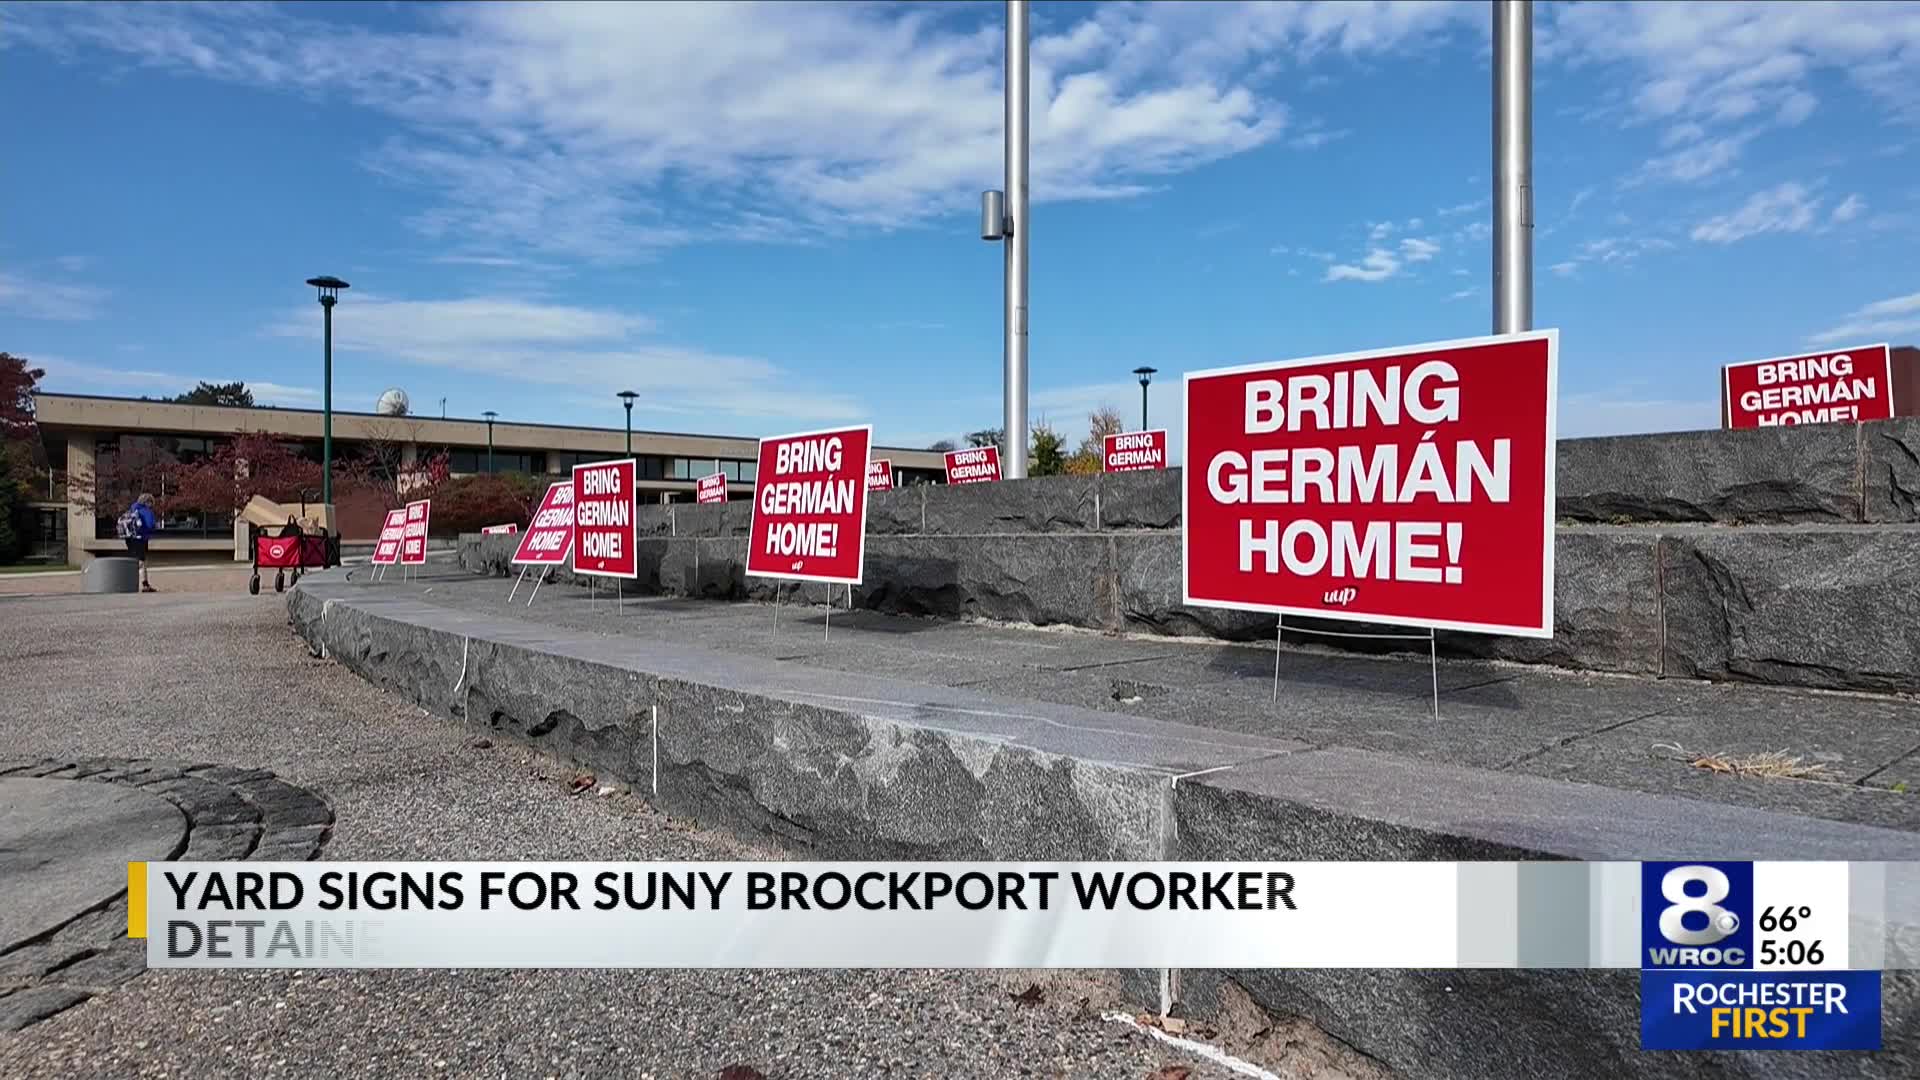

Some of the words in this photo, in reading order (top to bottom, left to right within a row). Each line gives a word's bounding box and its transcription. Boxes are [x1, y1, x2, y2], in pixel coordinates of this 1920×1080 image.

[1757, 354, 1854, 386] BRING
[1244, 360, 1460, 434] BRING
[1740, 377, 1876, 412] GERMÁN
[776, 437, 842, 475] BRING
[955, 451, 987, 465] BRING
[1108, 447, 1161, 466] GERMÁN
[1115, 434, 1153, 450] BRING
[584, 467, 620, 495] BRING
[951, 462, 996, 478] GERMÁN
[1206, 430, 1511, 504] GERMÁN
[551, 486, 573, 505] BRIN
[761, 474, 855, 515] GERMÁN
[577, 495, 629, 527] GERMÁN
[528, 530, 567, 551] HOME!
[583, 531, 622, 558] HOME!
[765, 522, 839, 557] HOME!
[1239, 519, 1463, 584] HOME!
